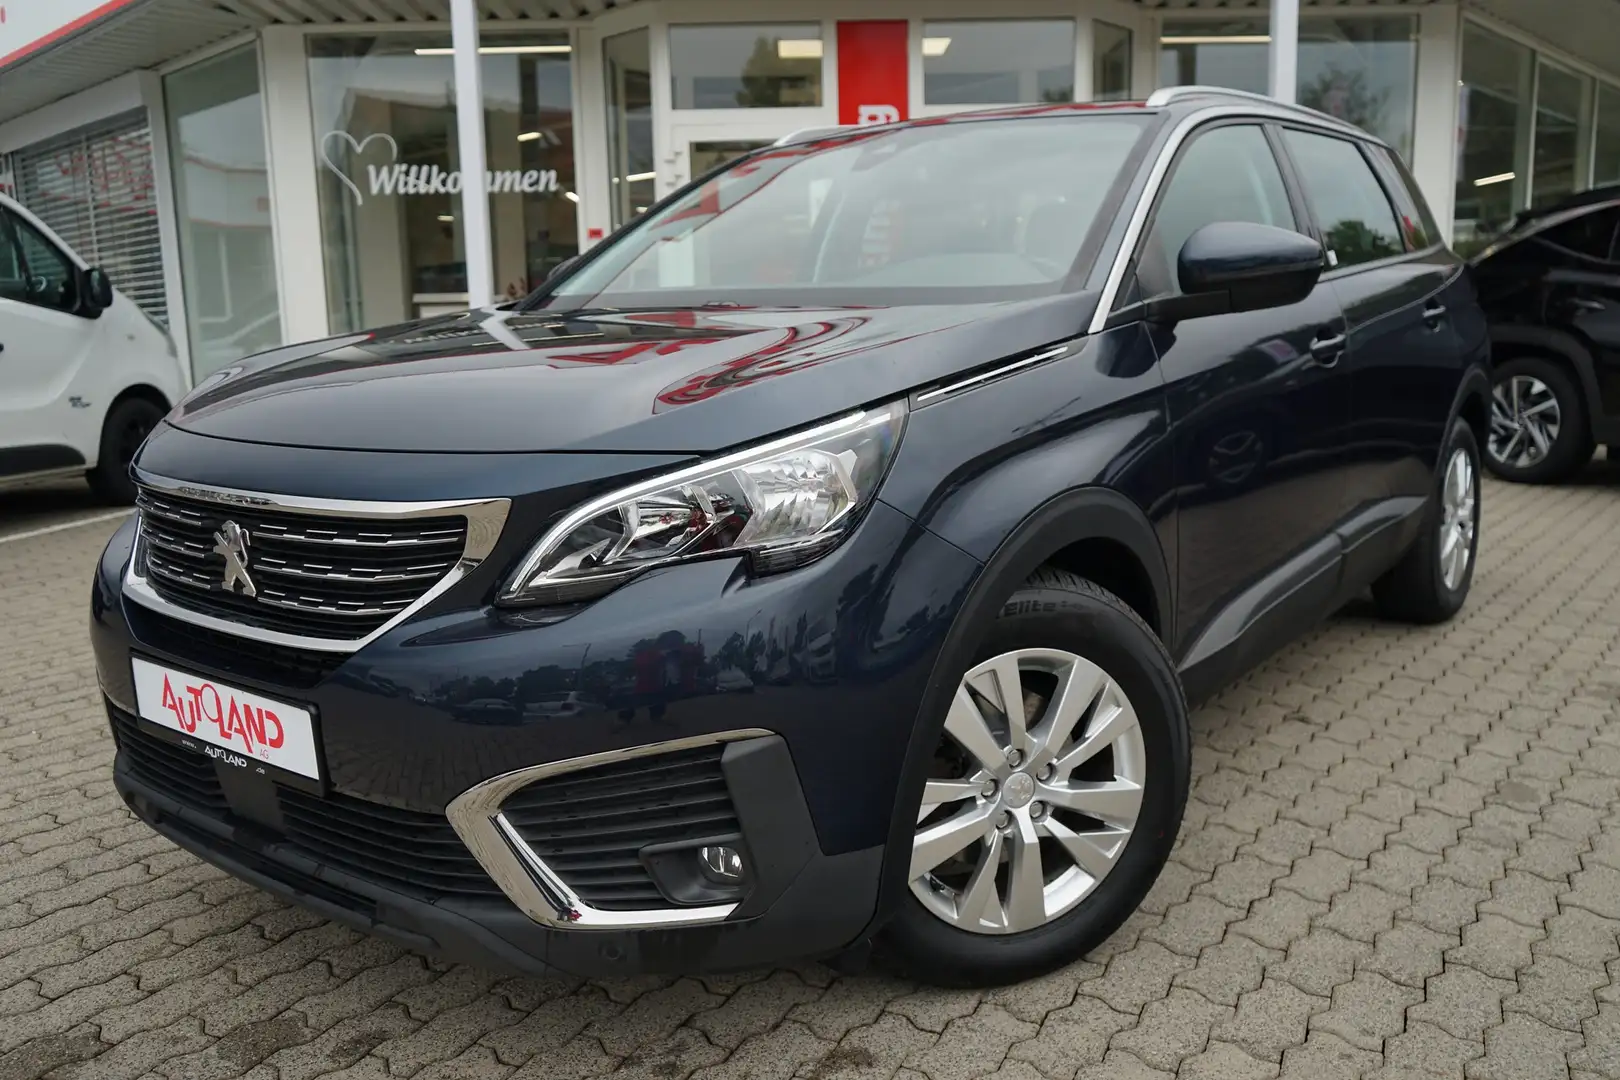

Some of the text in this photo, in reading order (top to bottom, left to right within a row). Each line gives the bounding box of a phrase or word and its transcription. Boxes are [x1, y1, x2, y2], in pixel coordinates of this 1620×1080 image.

[1004, 599, 1056, 617] Elite
[204, 745, 247, 768] AUTOLAND
[260, 748, 269, 760] AG
